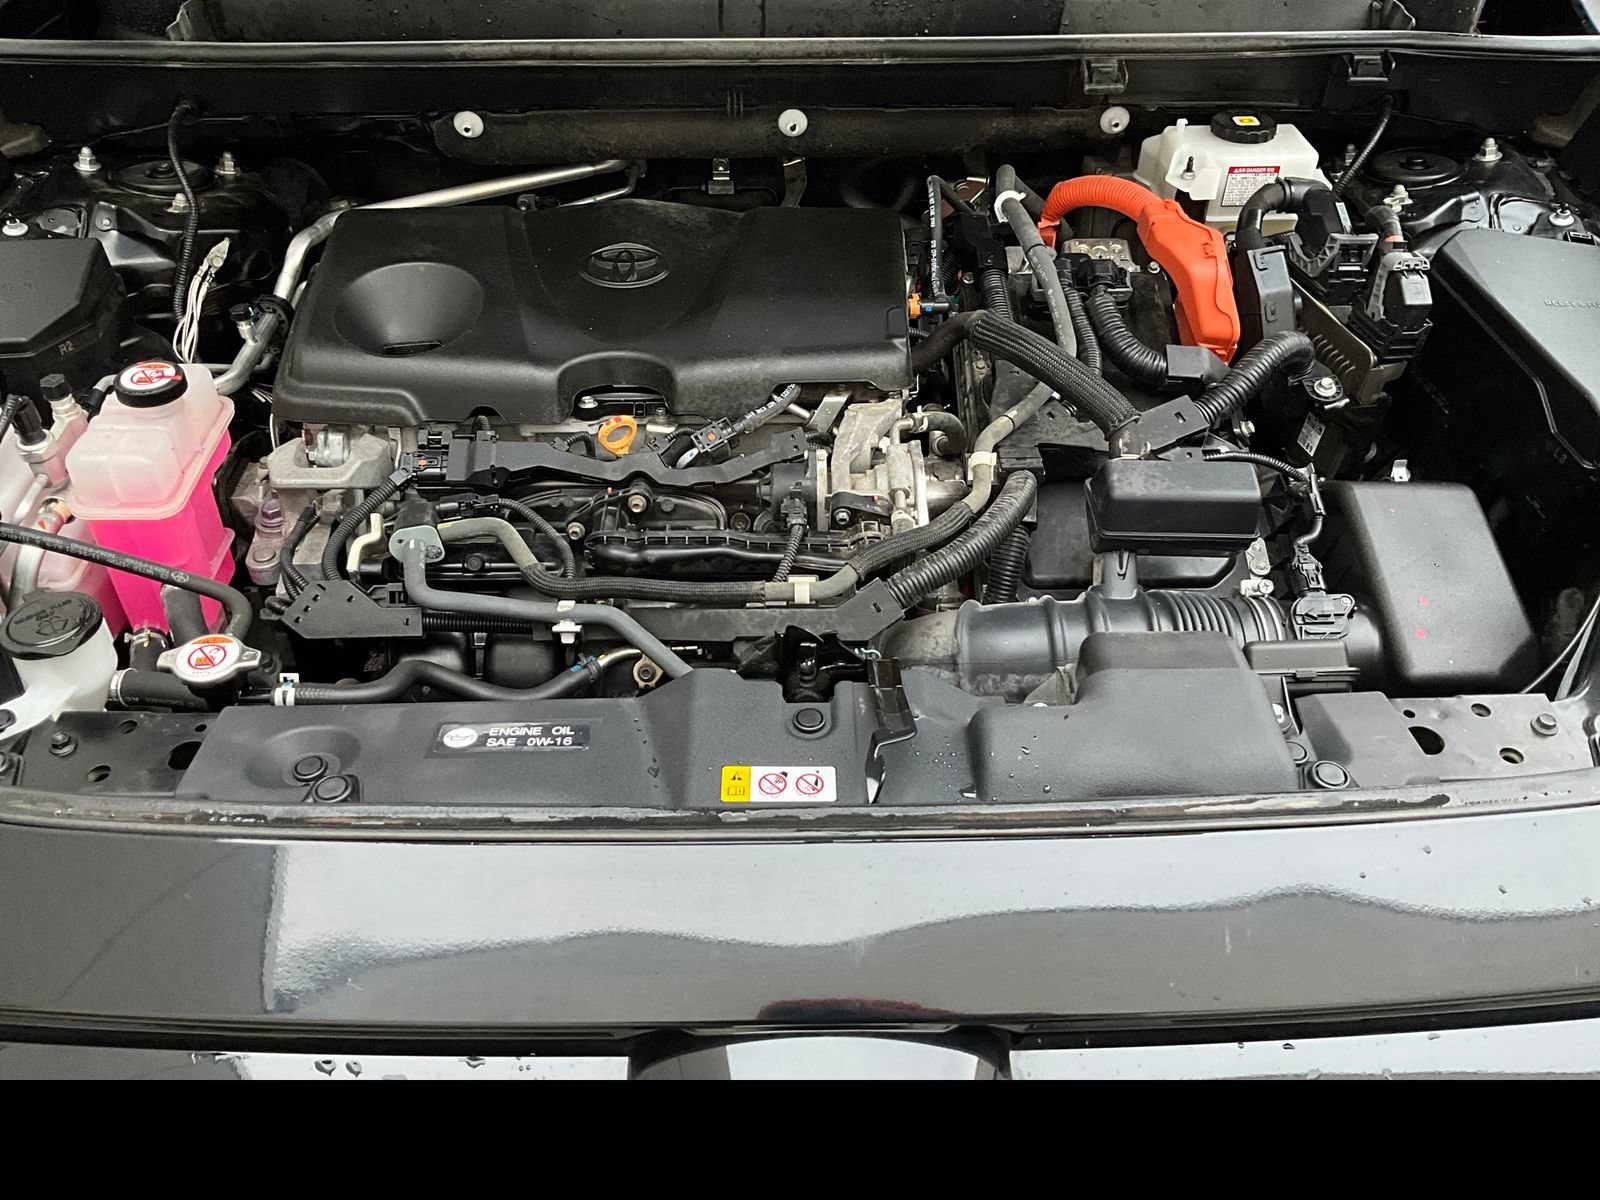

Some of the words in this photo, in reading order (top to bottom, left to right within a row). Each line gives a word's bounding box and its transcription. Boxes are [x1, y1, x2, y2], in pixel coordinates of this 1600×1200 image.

[58, 340, 75, 356] R2
[488, 726, 543, 736] ENGINE
[551, 726, 575, 735] OIL
[486, 737, 517, 746] SAE
[526, 736, 573, 746] 0W-16
